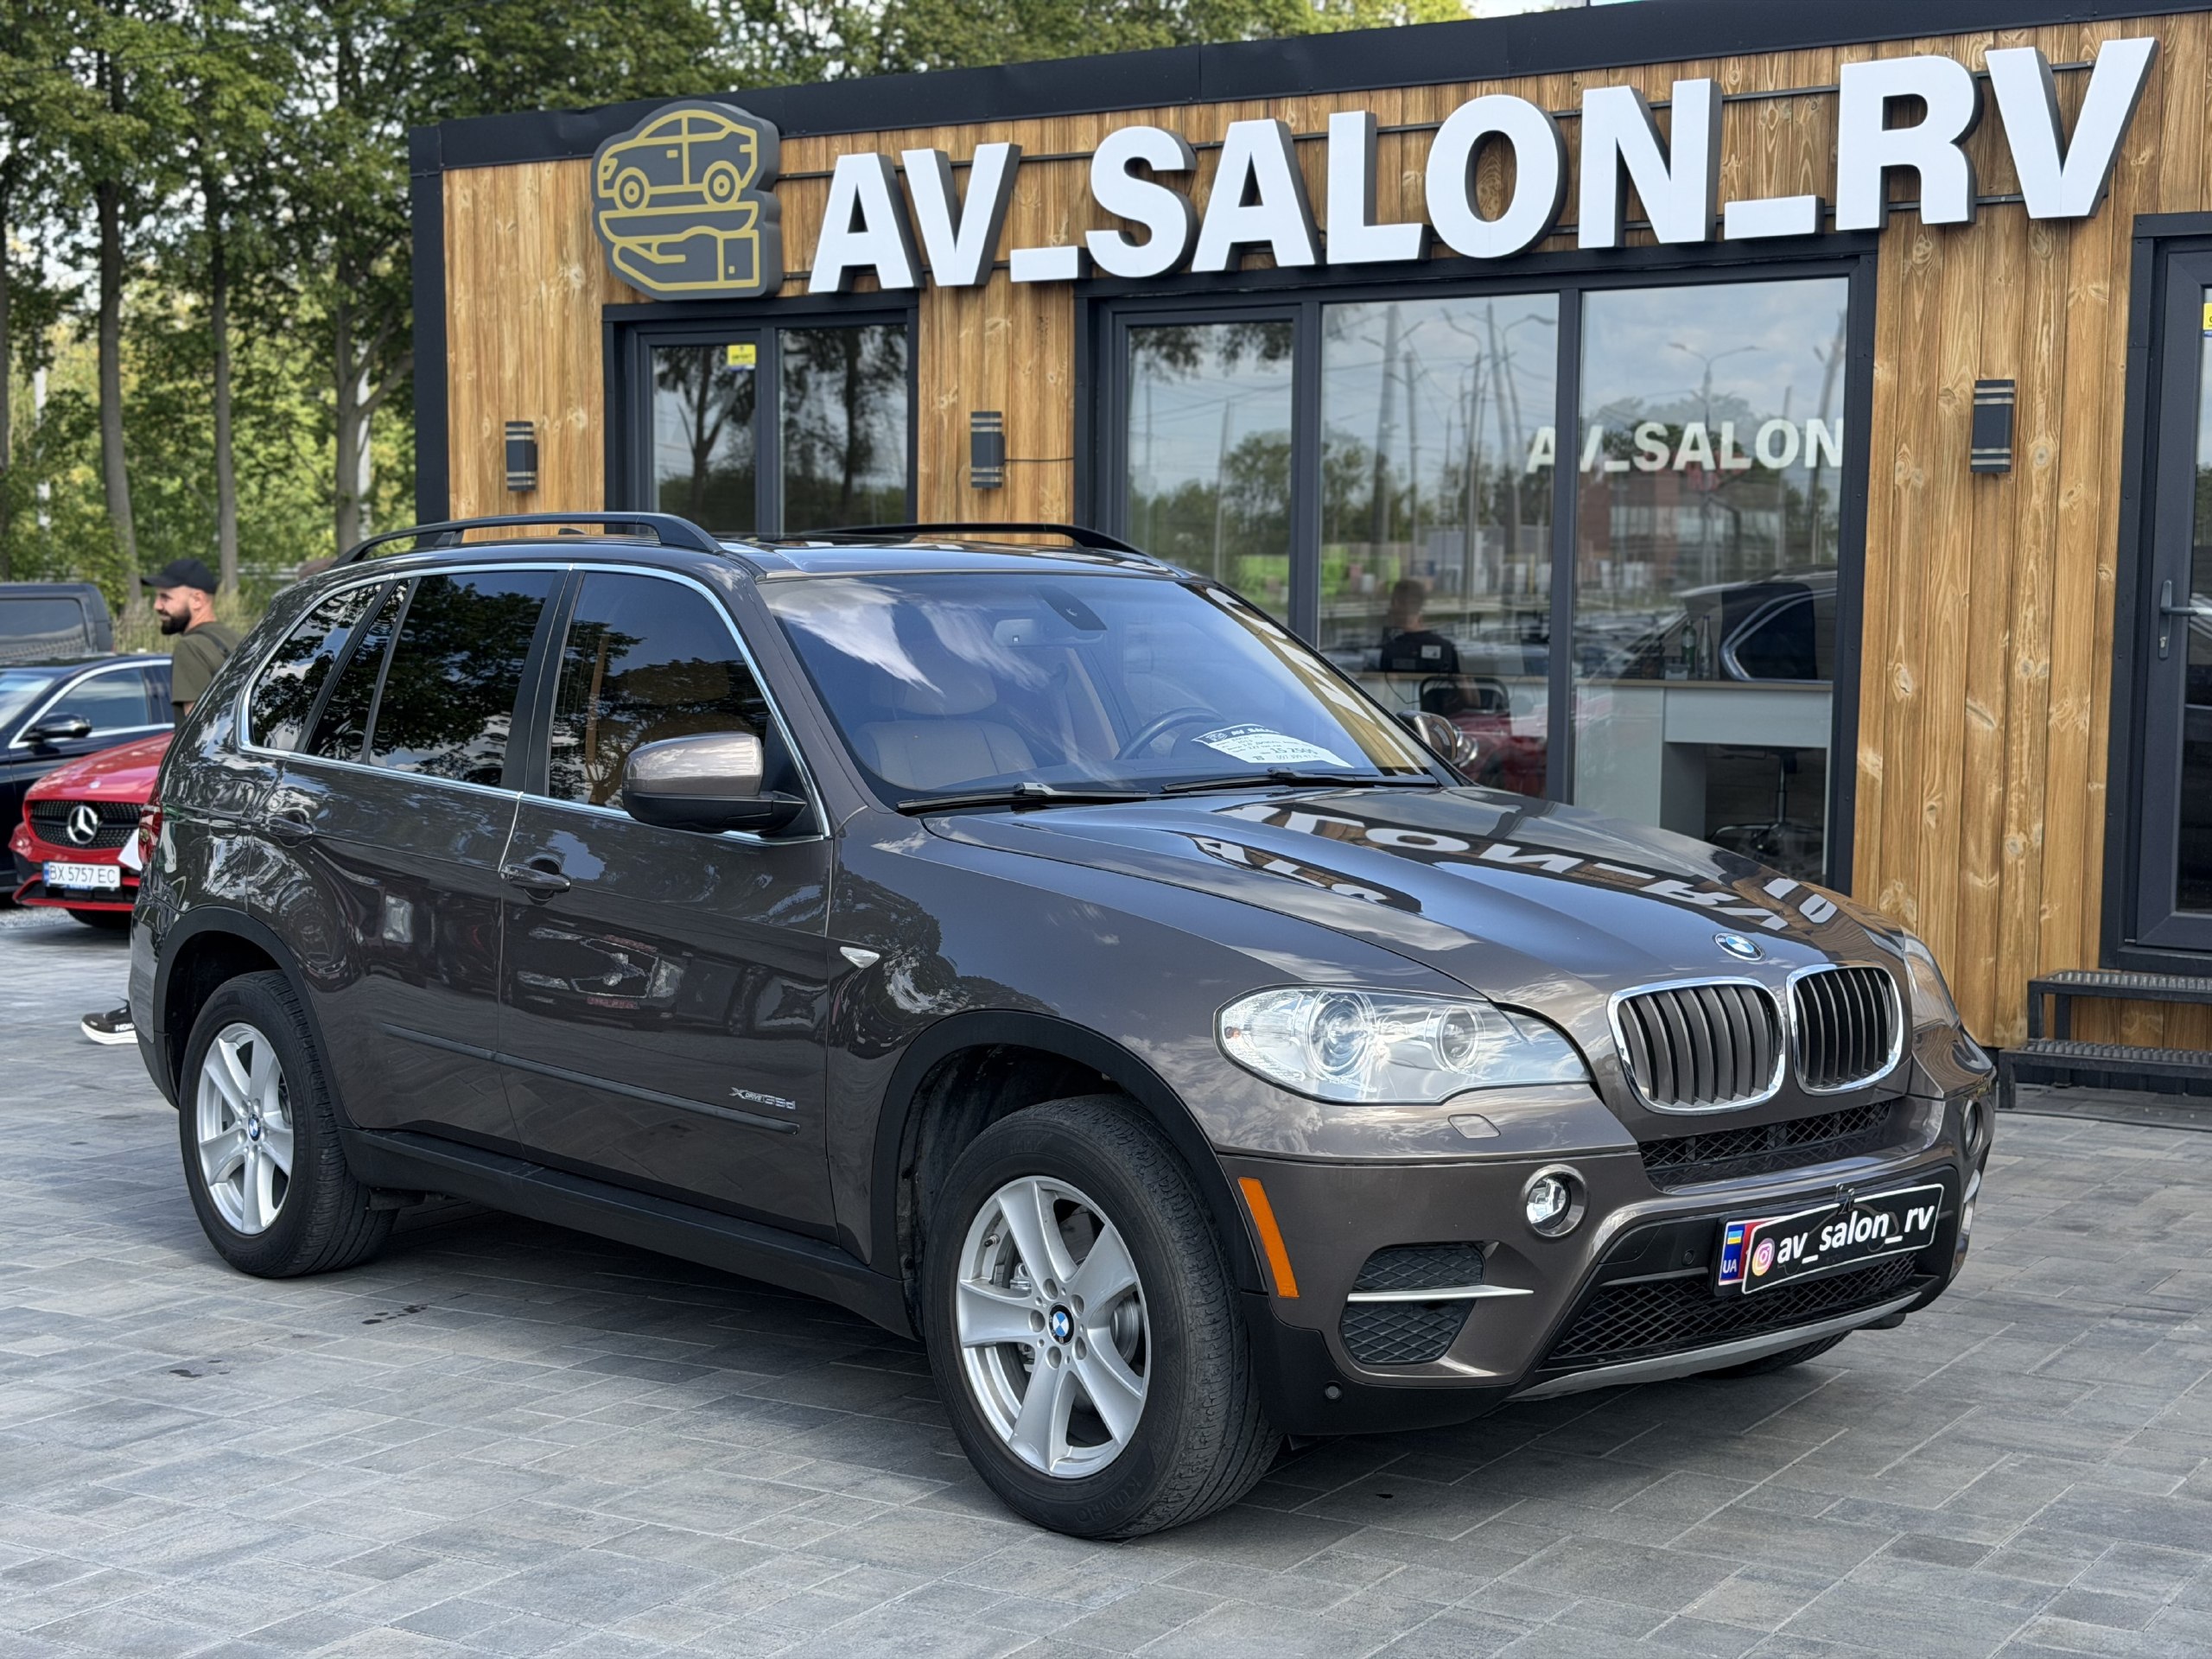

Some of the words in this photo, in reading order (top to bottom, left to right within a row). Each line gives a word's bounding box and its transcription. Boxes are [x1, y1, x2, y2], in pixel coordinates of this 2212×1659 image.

[808, 37, 2157, 294] AV_SALON_RV
[49, 865, 65, 880] BX
[68, 867, 94, 883] 5757
[98, 868, 116, 884] EC
[1777, 1205, 1936, 1264] av_salon_rv
[1722, 1258, 1738, 1274] UA
